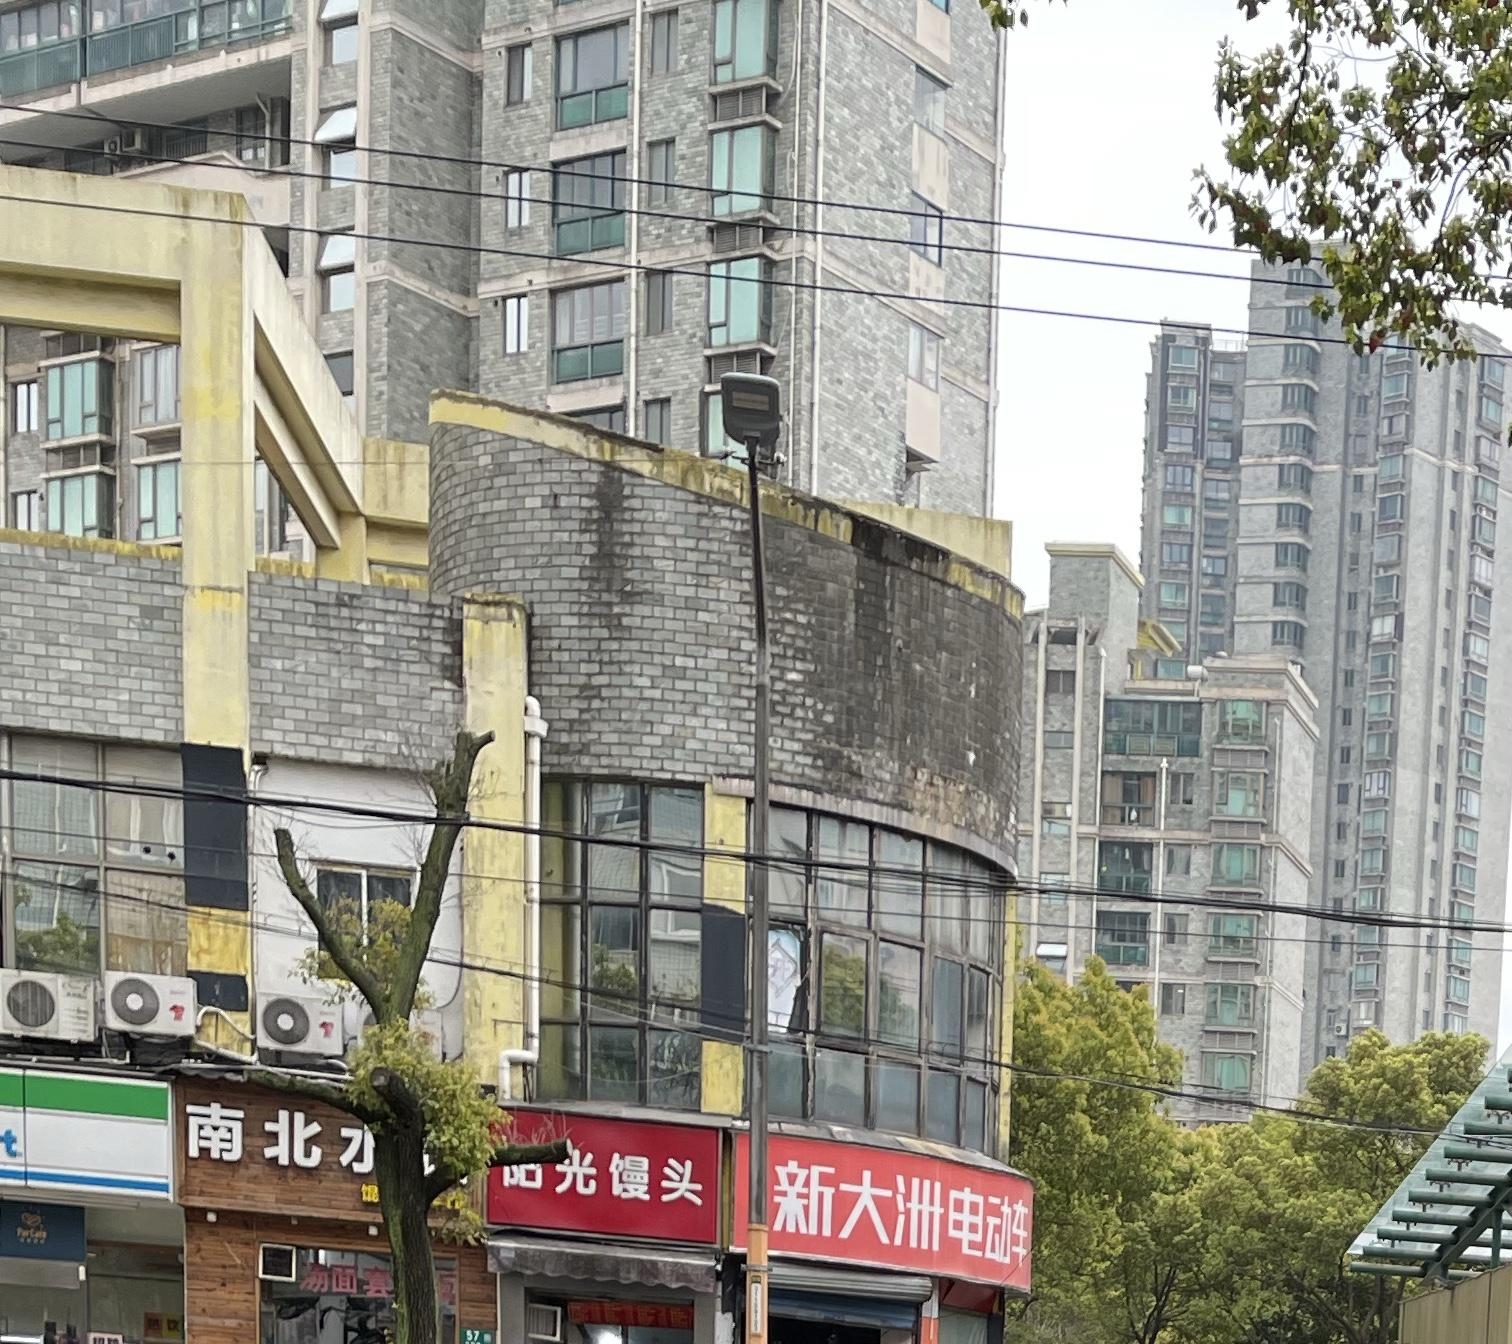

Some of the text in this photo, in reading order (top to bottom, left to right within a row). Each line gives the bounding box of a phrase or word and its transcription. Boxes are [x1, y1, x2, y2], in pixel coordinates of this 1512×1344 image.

[502, 1149, 703, 1206] 阳光馒头
[773, 1160, 1029, 1267] 新大洲电动车
[466, 1329, 480, 1342] 57
